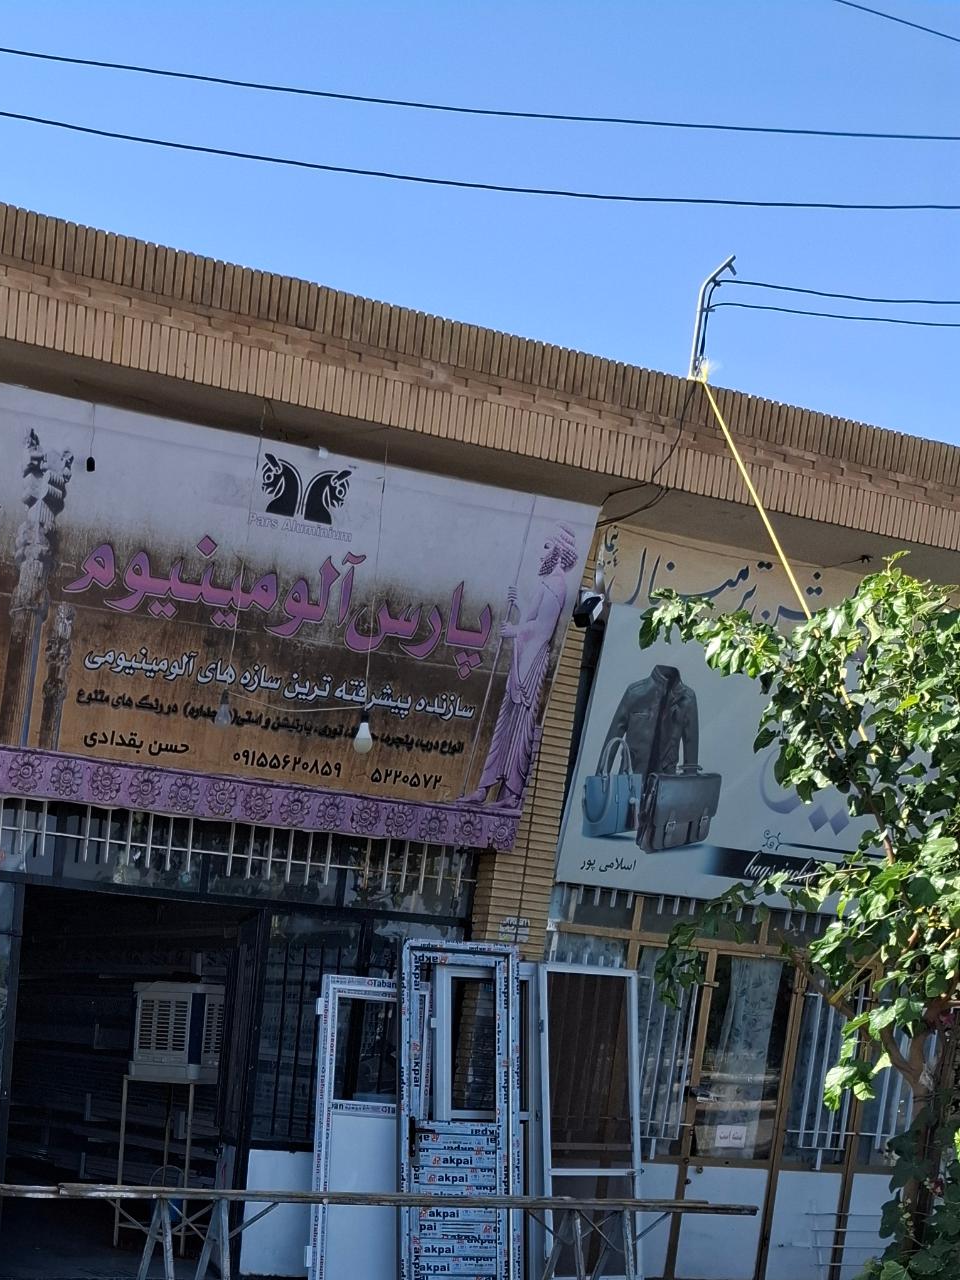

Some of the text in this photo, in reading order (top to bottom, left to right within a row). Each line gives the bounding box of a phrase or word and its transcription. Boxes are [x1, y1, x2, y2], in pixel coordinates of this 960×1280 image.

[249, 512, 352, 543] Pars Aluminium
[62, 534, 492, 680] پارس آلومینیوم
[84, 647, 476, 720] سازنده پیشرفته ترین سازه های آلومینیومی
[84, 730, 190, 756] حسن بقدادی
[233, 750, 342, 778] ۰۹۱۵۵۶۲۰۸۵۹
[370, 767, 443, 790] ۵۲۲۰۵۷۲
[580, 858, 637, 873] اسلامی پور
[373, 977, 396, 988] Taban
[443, 1156, 473, 1166] akpai
[438, 1175, 468, 1183] akpai
[429, 1210, 459, 1219] akpai
[424, 1246, 455, 1254] akpai
[420, 1264, 449, 1273] akpai
